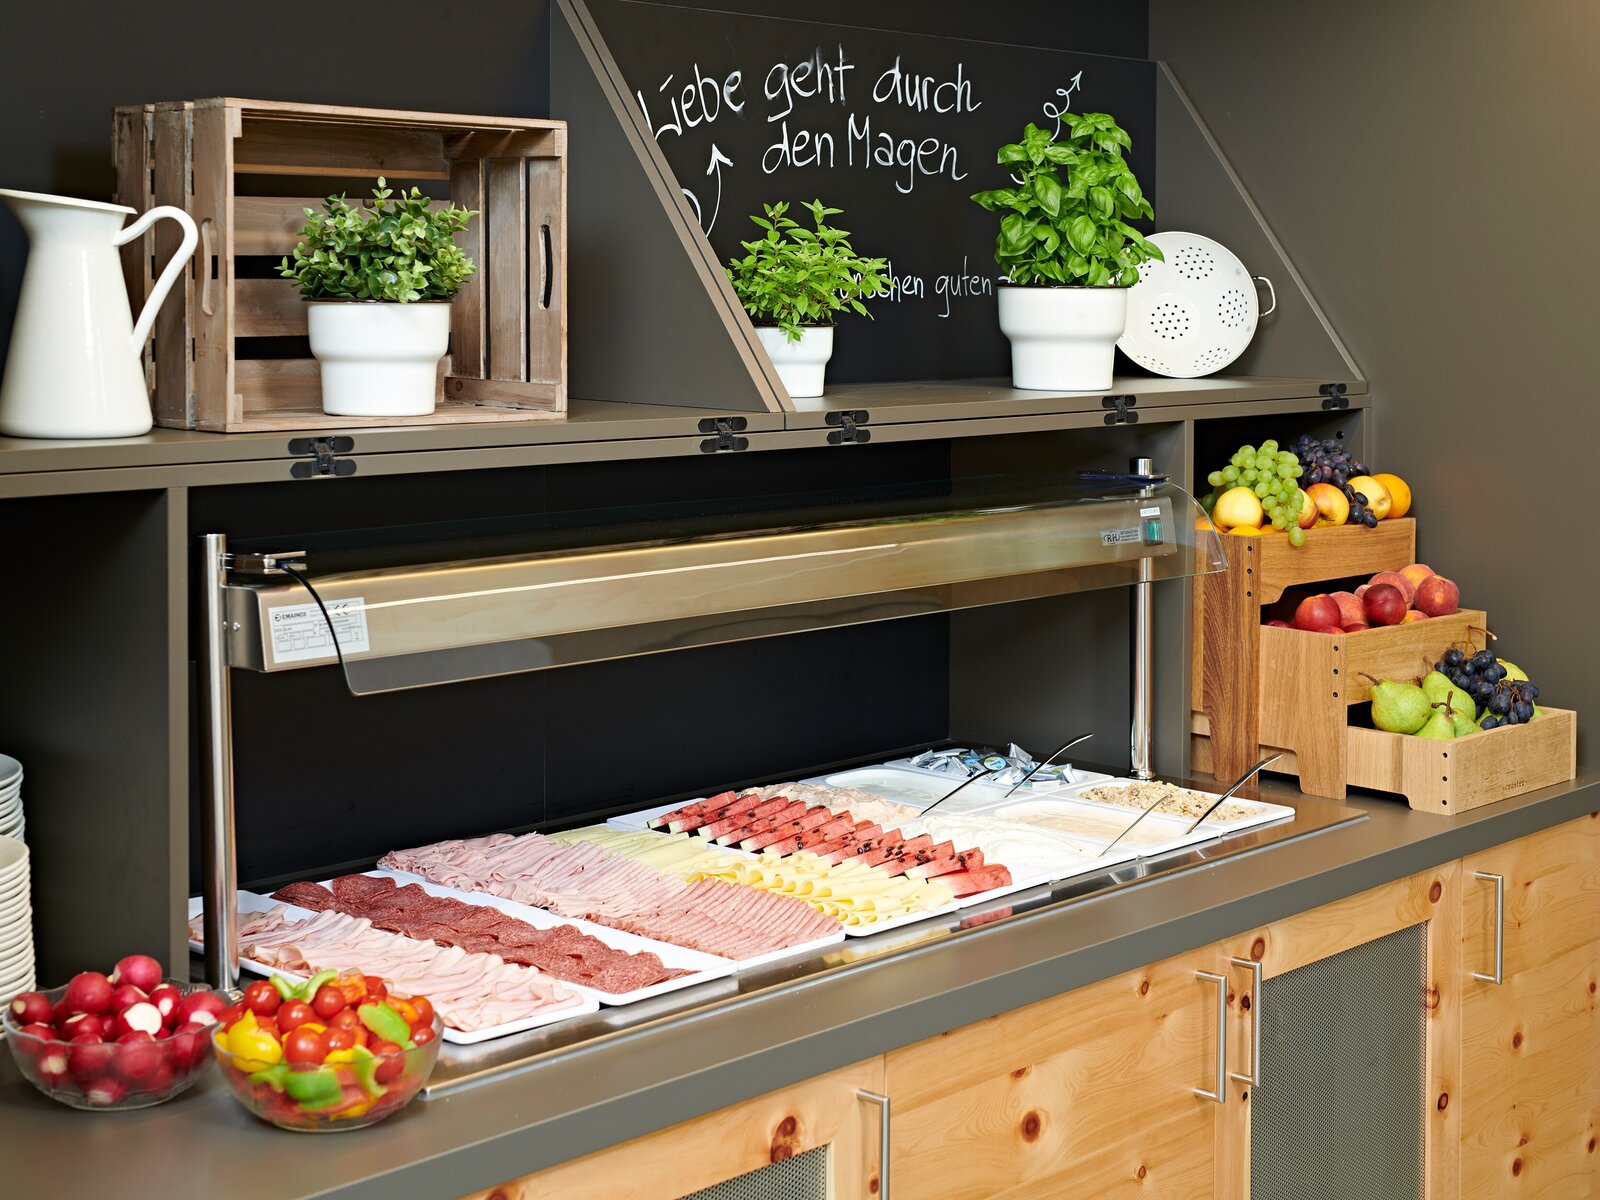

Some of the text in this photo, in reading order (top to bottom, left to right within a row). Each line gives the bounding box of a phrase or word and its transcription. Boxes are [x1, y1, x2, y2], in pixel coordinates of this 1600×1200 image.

[637, 43, 982, 141] Liebe geht durch
[762, 113, 968, 194] den Magen
[935, 255, 992, 318] guten
